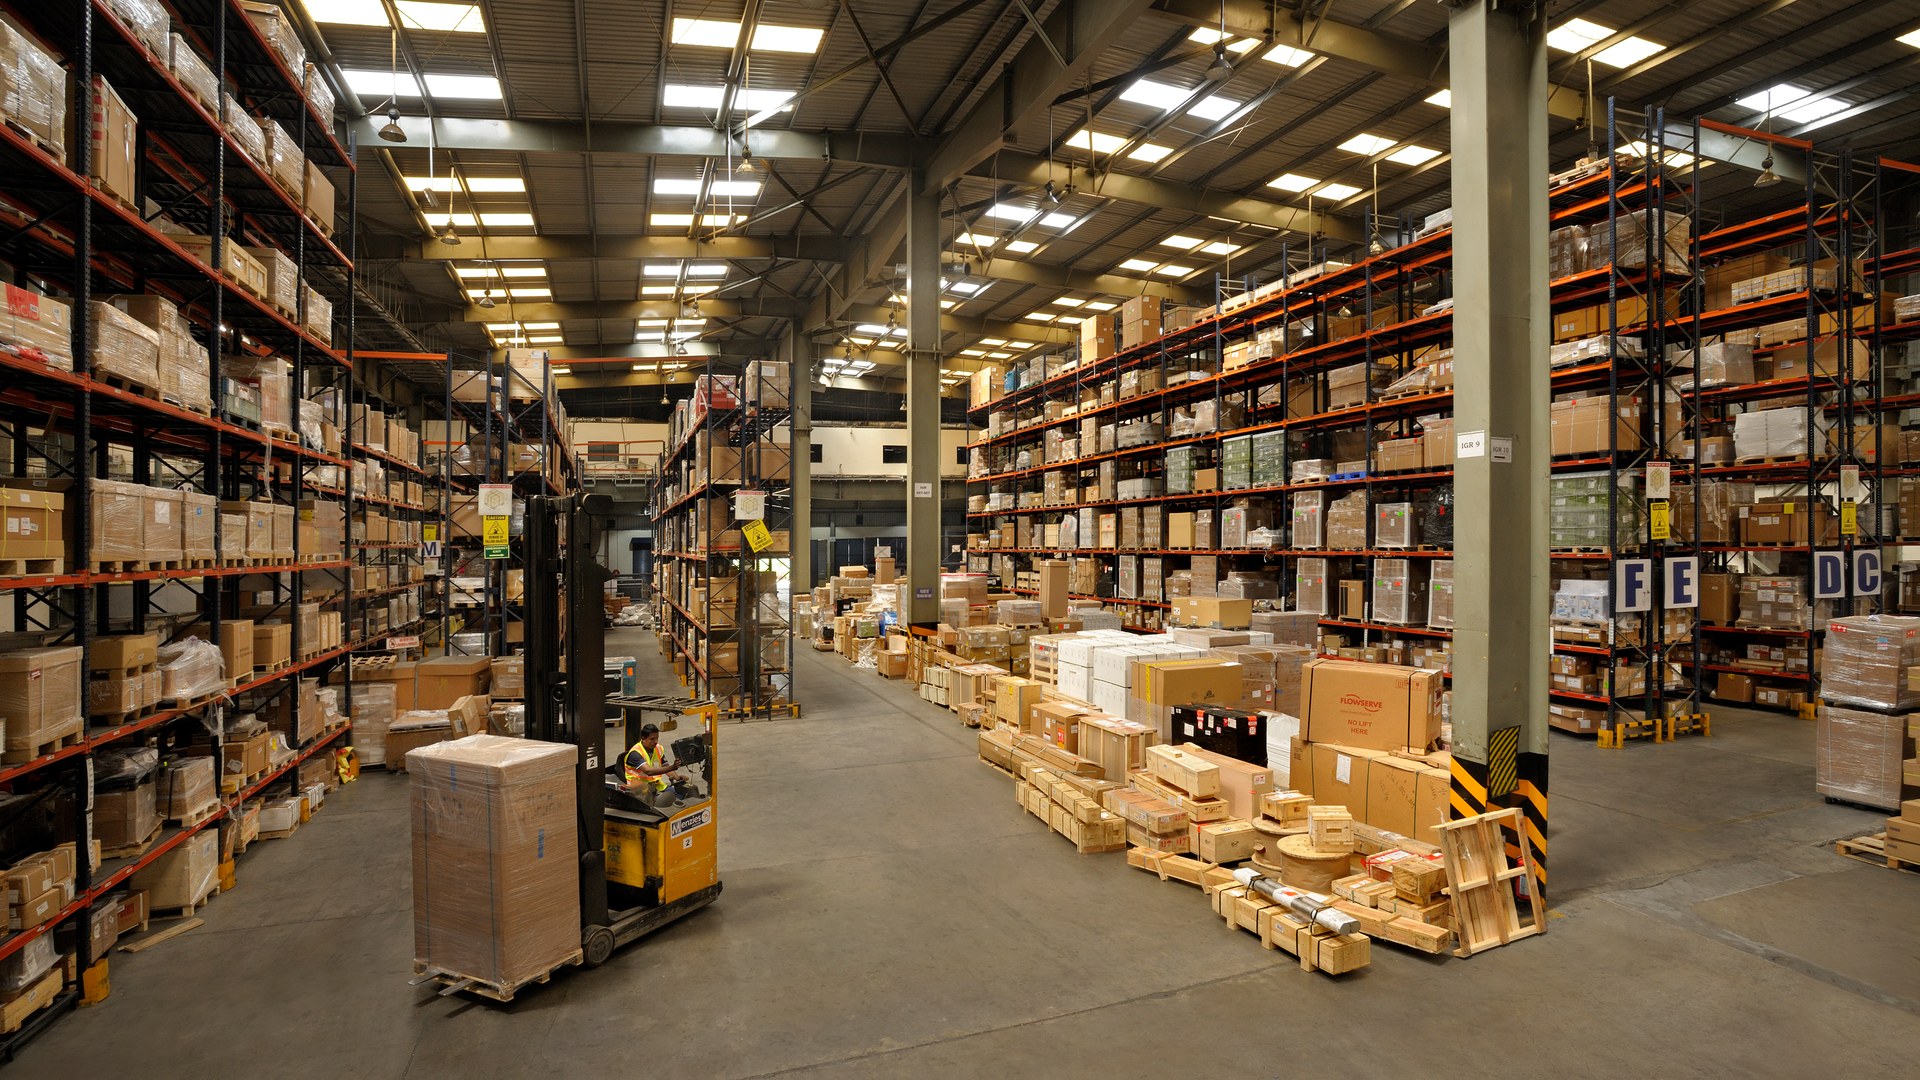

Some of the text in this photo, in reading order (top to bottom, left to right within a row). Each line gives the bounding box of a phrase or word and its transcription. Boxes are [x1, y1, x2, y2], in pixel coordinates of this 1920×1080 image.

[1461, 440, 1480, 449] IGR 9
[423, 541, 437, 556] M
[1819, 555, 1841, 594] D
[1858, 553, 1878, 592] C
[1625, 563, 1644, 608] F
[1673, 561, 1692, 604] E
[1340, 697, 1383, 709] FLOWSERVE
[1358, 720, 1372, 728] LIFT
[1350, 727, 1368, 735] HERE
[590, 759, 595, 767] 2
[671, 815, 702, 837] Menzies
[685, 839, 690, 847] 2
